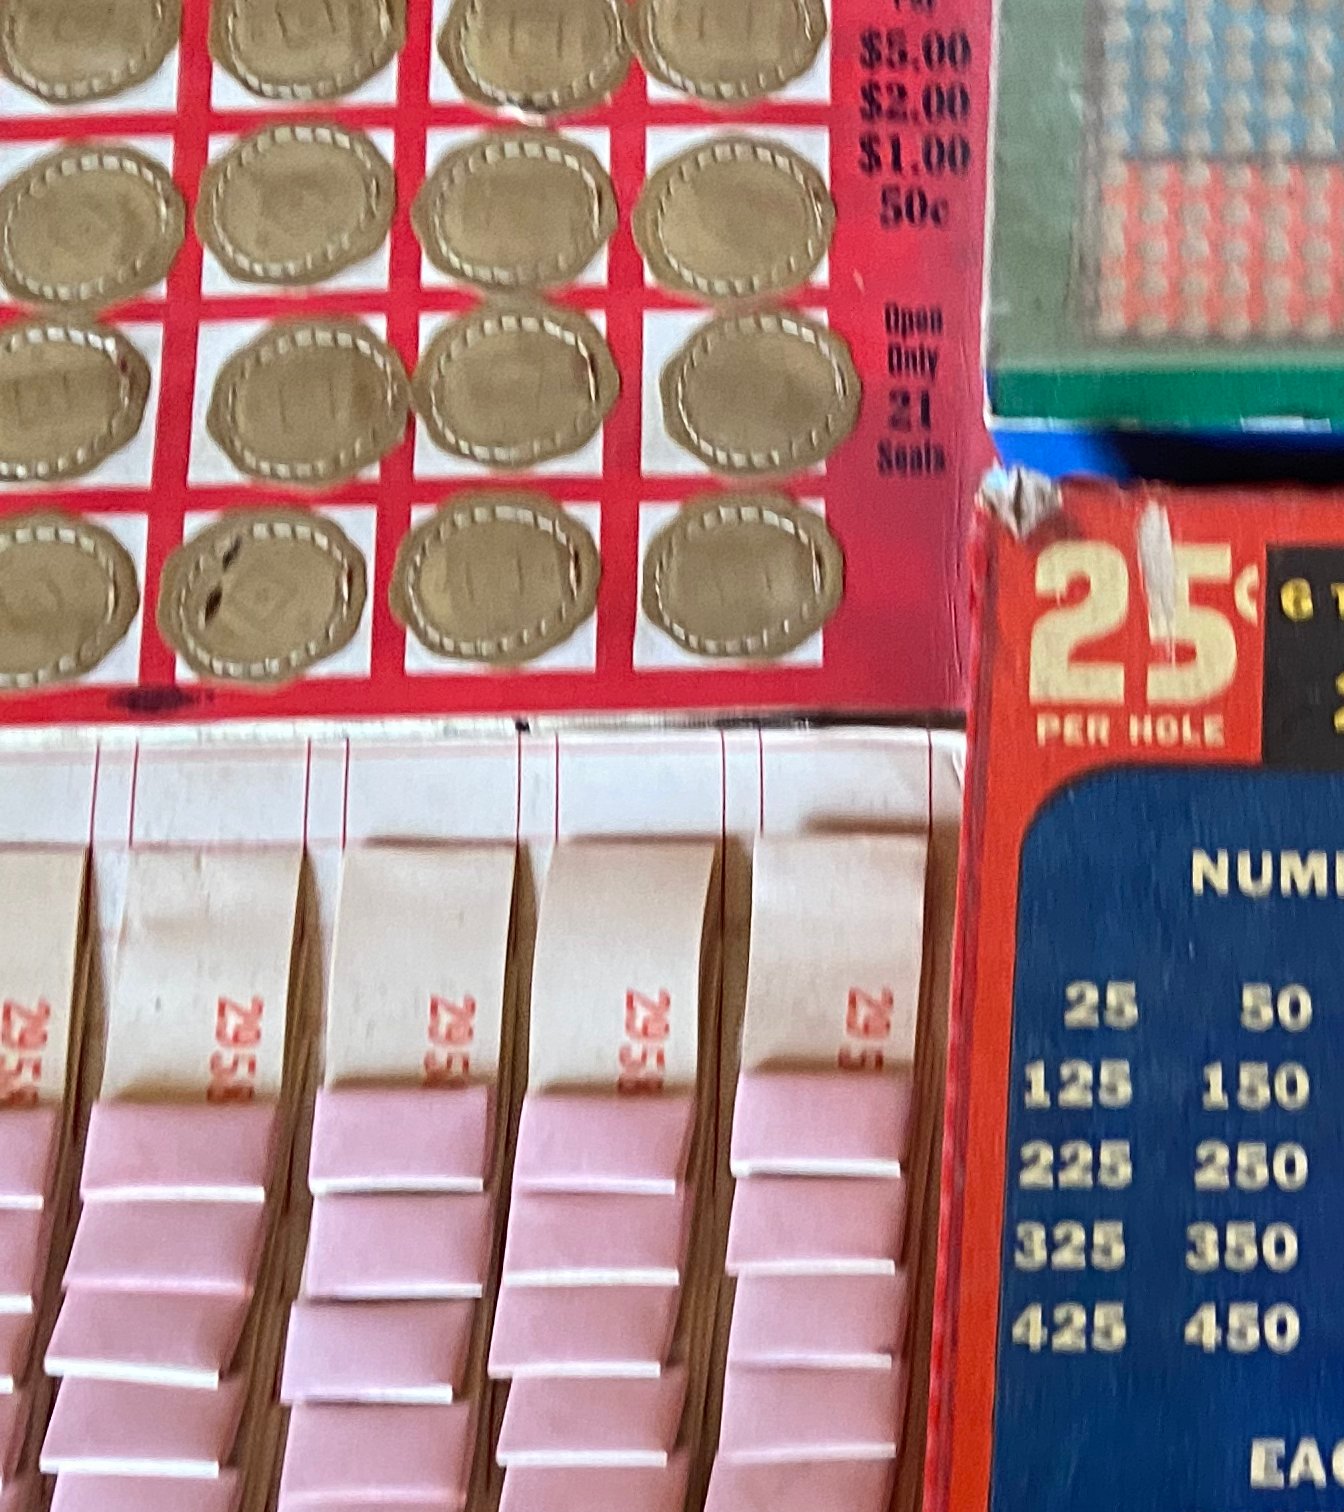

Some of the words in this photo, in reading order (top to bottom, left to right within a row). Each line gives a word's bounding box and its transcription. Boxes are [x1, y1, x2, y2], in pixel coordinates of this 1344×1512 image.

[860, 27, 971, 72] $5.00
[860, 80, 970, 124] $2.00
[859, 132, 970, 177] $1.00
[885, 302, 943, 340] Open
[888, 343, 939, 383] Only
[889, 389, 931, 432] 21
[877, 438, 945, 477] Seals
[1280, 577, 1313, 622] 6
[1037, 713, 1110, 748] PER
[1130, 713, 1226, 748] HOLE
[1064, 980, 1139, 1030] 25
[1241, 984, 1313, 1032] 50
[1024, 1059, 1132, 1110] 125
[1203, 1061, 1310, 1112] 150
[1019, 1140, 1132, 1190] 225
[1195, 1141, 1308, 1192] 250
[1014, 1219, 1126, 1271] 325
[1185, 1221, 1299, 1272] 350
[1012, 1300, 1127, 1353] 425
[1184, 1302, 1301, 1354] 450
